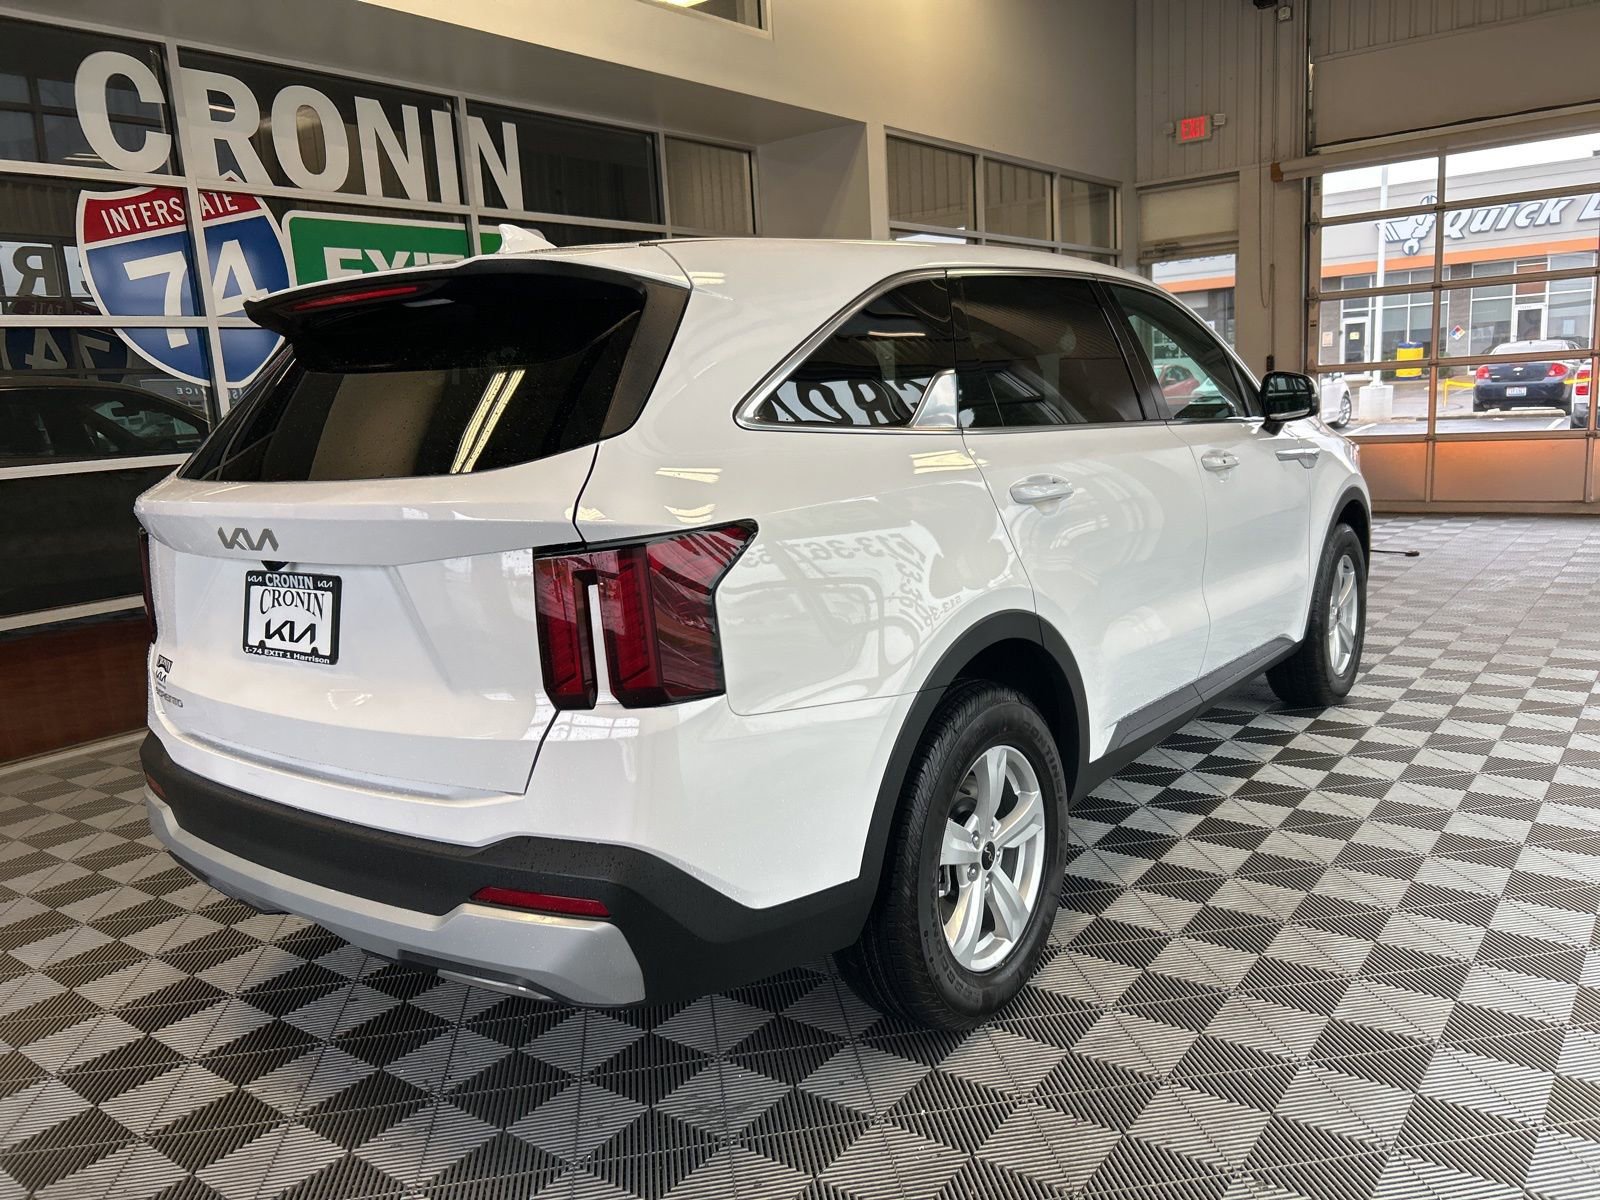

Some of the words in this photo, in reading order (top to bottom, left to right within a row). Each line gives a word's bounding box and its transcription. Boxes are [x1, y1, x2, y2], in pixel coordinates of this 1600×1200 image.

[74, 51, 525, 211] CRONIN
[1181, 115, 1205, 140] EXIT
[100, 192, 239, 234] INTERSATE
[123, 239, 269, 349] 74
[265, 573, 314, 590] CRONIN
[260, 588, 326, 621] CRONIN
[245, 646, 263, 655] I-74
[264, 649, 284, 658] EXIT
[293, 652, 331, 665] Harrison
